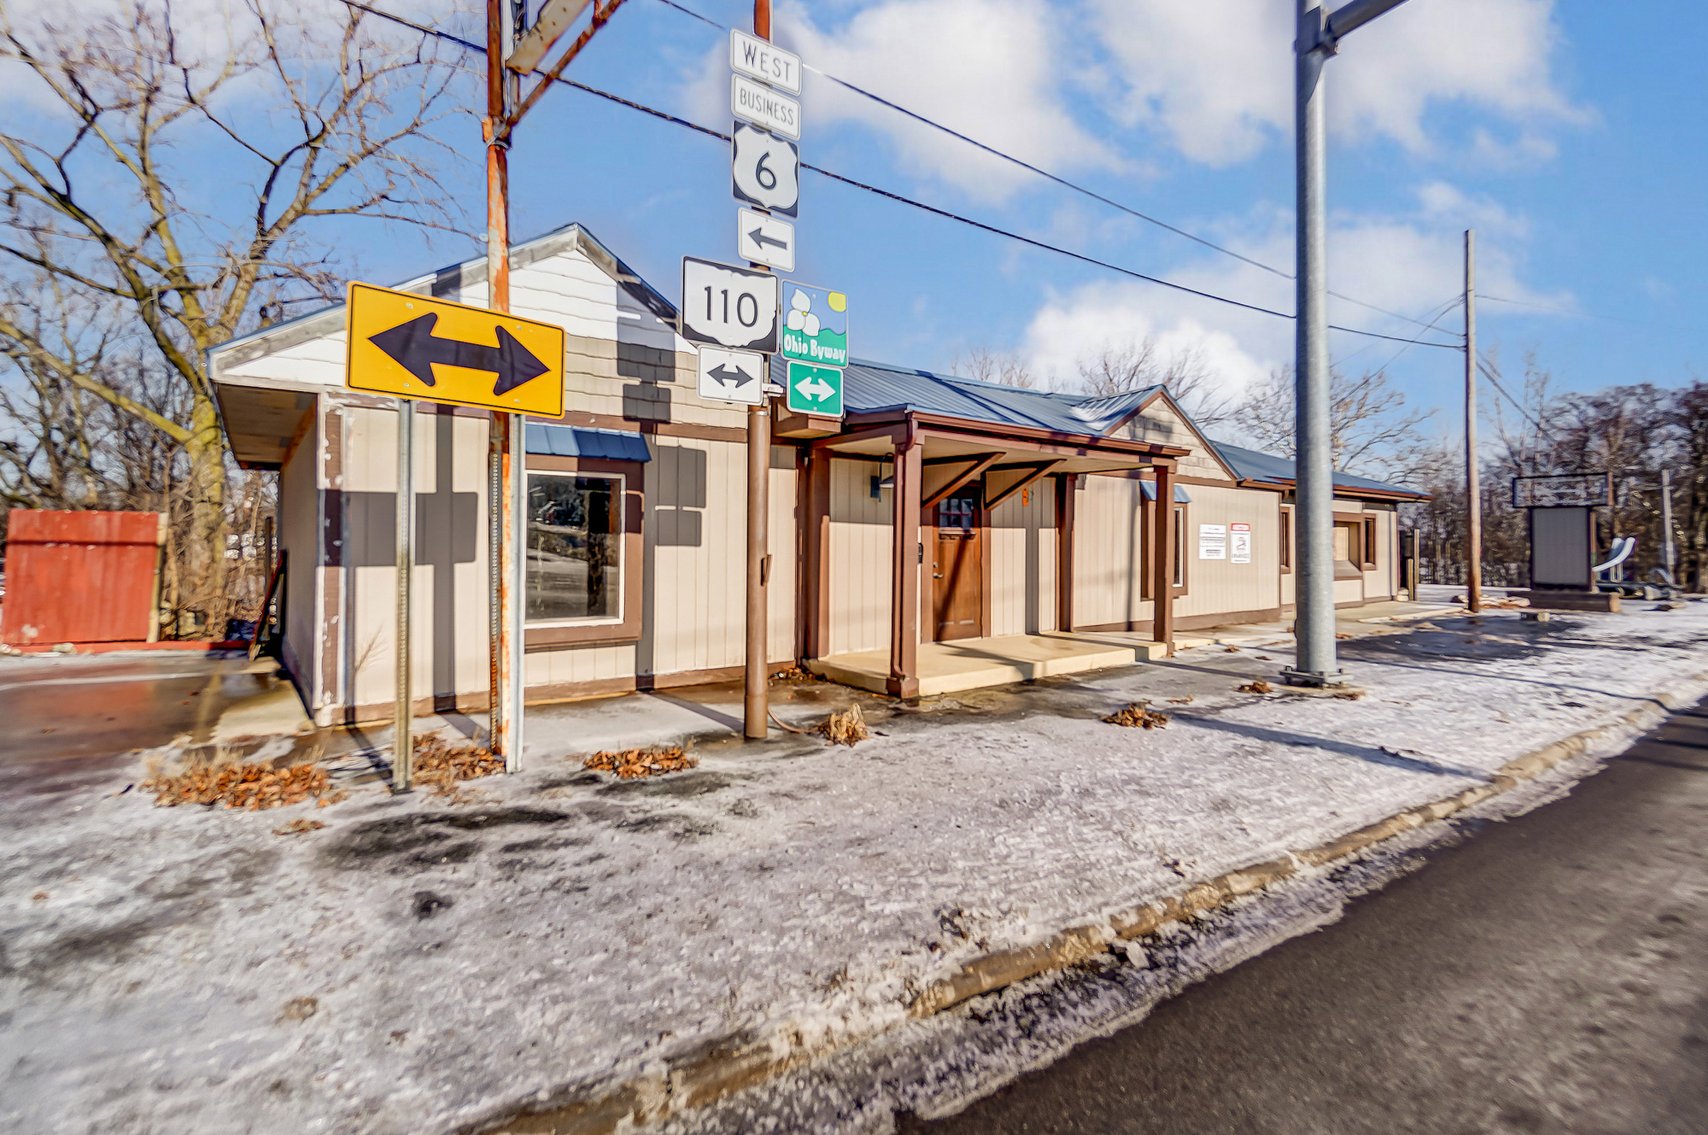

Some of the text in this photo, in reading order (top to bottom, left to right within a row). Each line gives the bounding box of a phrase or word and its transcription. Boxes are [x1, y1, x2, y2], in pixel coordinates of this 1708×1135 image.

[743, 41, 792, 82] WEST
[739, 87, 794, 126] BUSINESS
[755, 151, 777, 190] 6
[704, 285, 758, 328] 110
[784, 334, 846, 363] Ohio Byway
